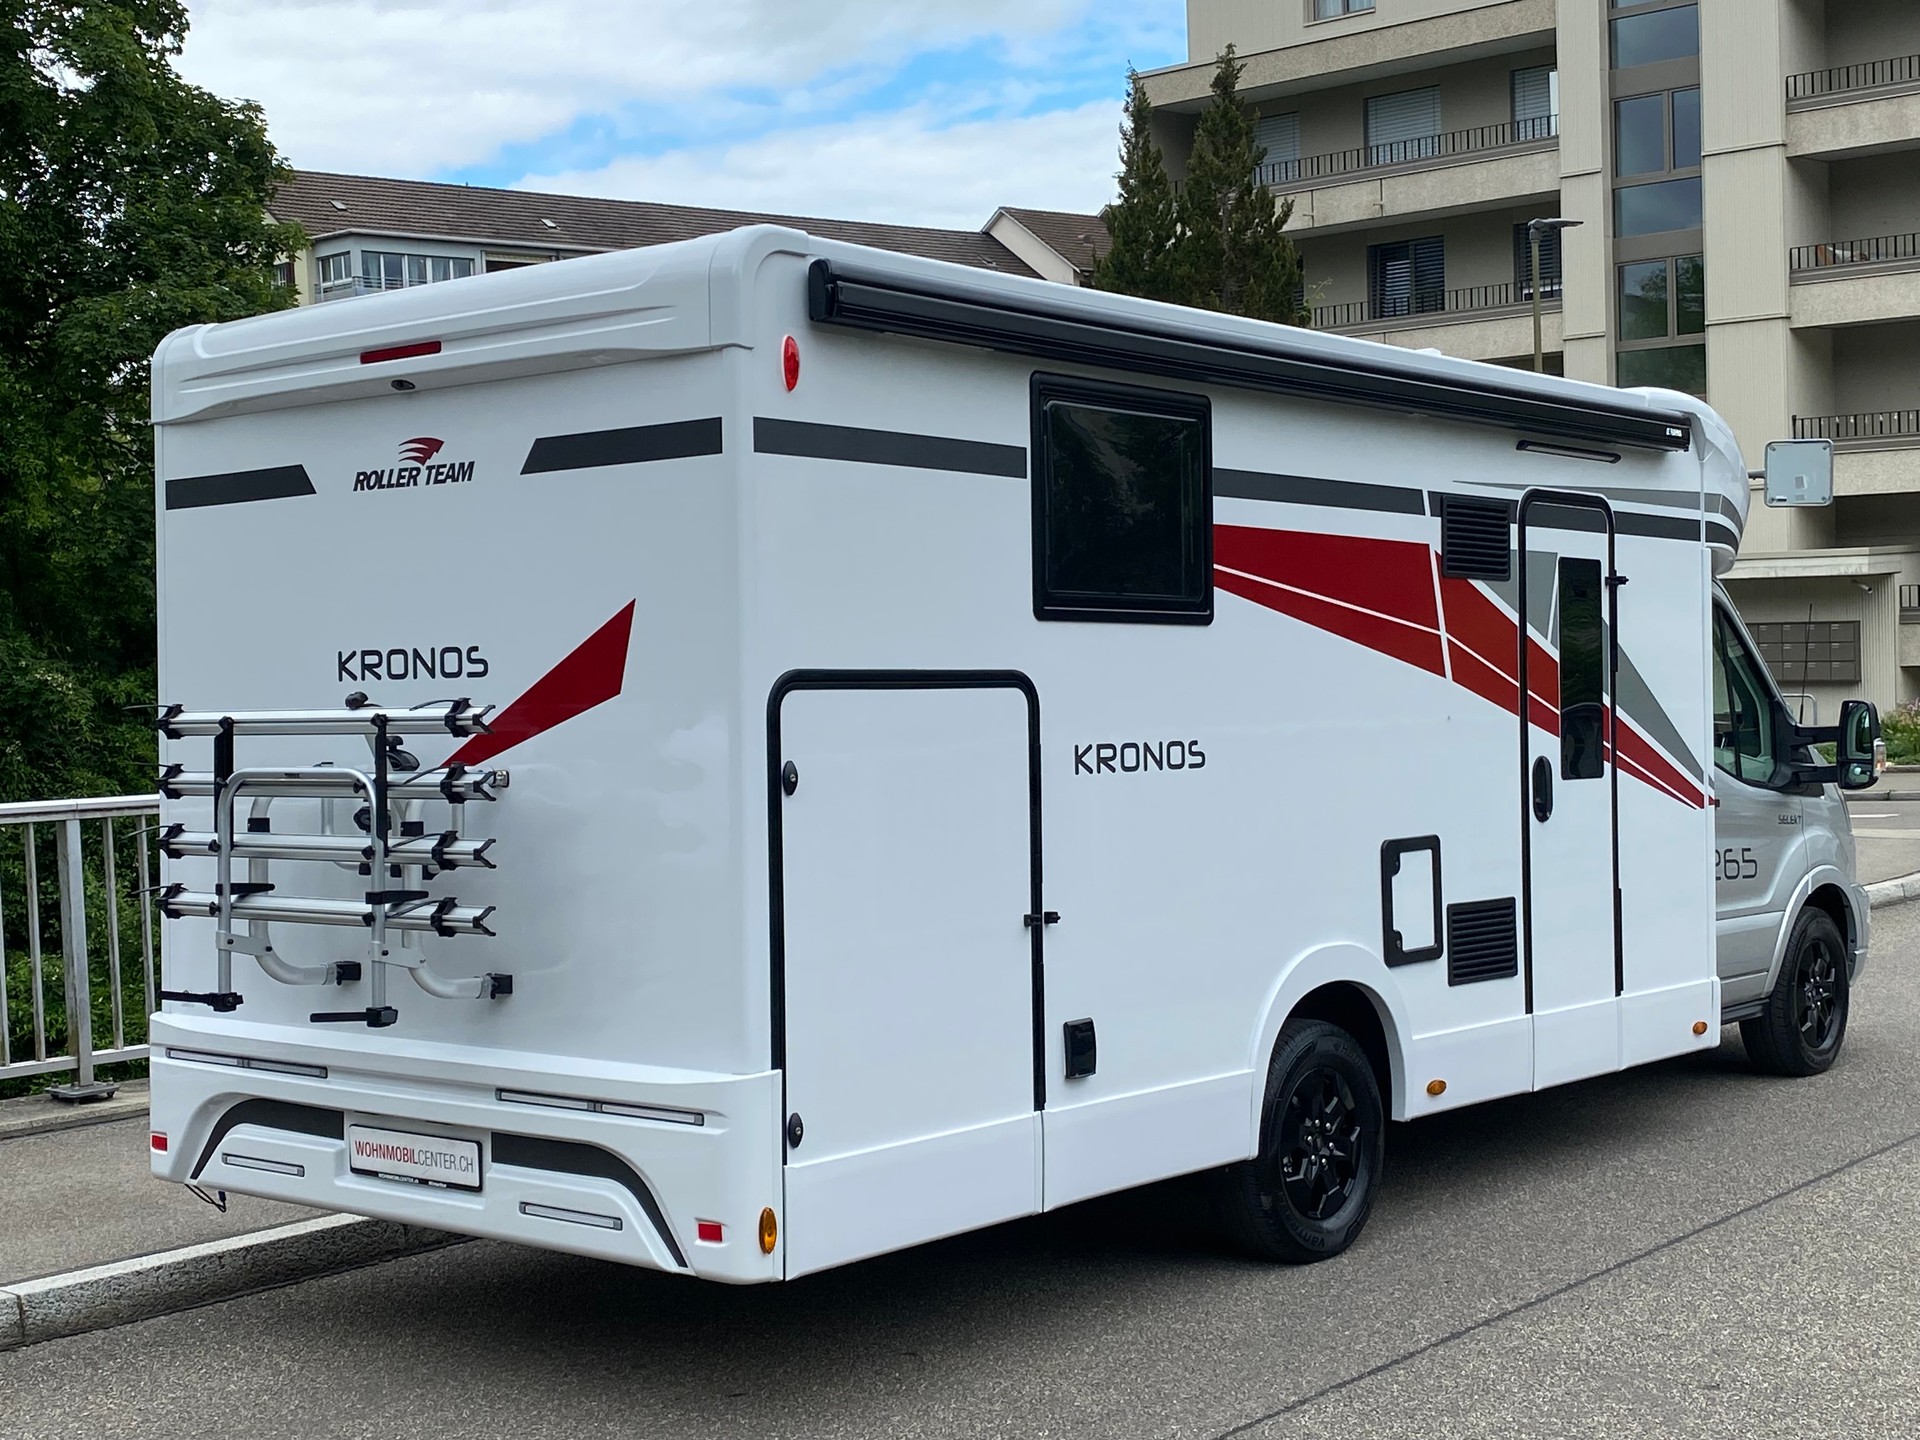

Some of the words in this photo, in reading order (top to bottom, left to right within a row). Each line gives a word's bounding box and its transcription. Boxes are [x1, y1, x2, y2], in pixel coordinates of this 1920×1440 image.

[353, 466, 421, 492] ROLLER
[425, 461, 475, 486] TEAM
[337, 645, 489, 682] KRONOS
[1074, 740, 1206, 775] KRONOS
[355, 1140, 474, 1173] WOHNMOBILCENTER.CH
